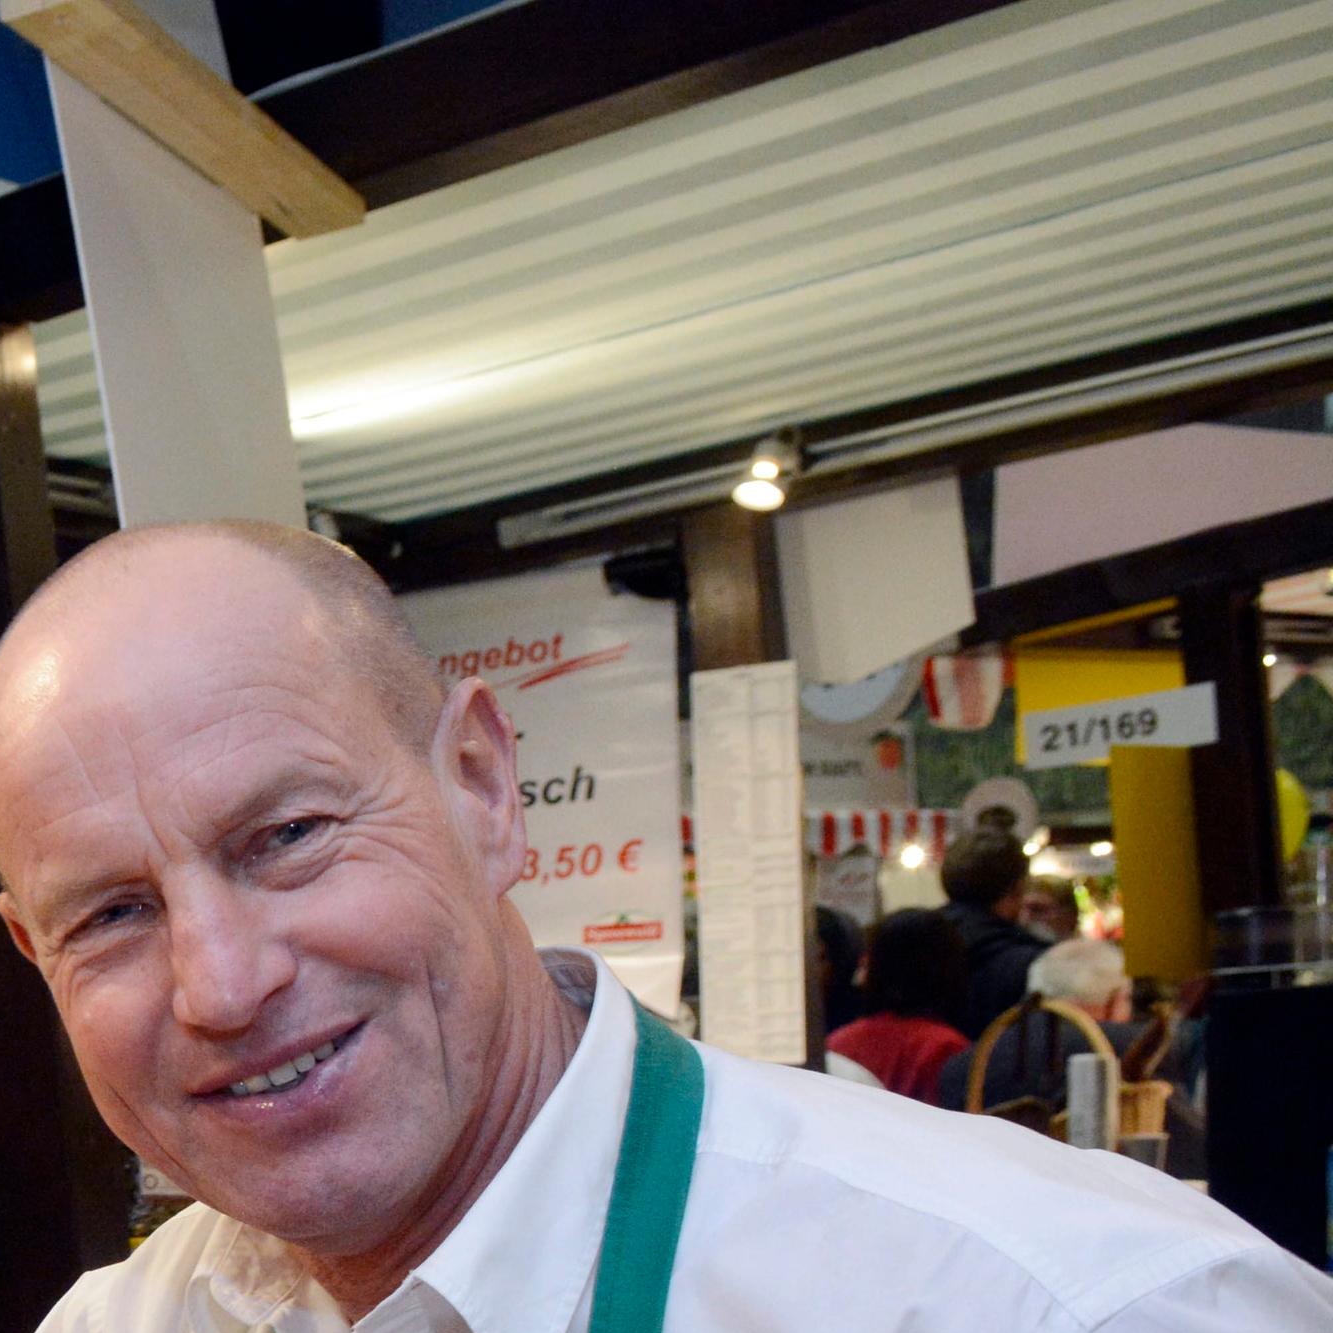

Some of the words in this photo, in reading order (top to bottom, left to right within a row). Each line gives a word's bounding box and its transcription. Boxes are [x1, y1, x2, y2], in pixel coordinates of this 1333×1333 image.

[437, 632, 566, 678] ngebot
[1038, 707, 1160, 753] 21/169
[519, 765, 597, 808] sch
[617, 837, 645, 874] €
